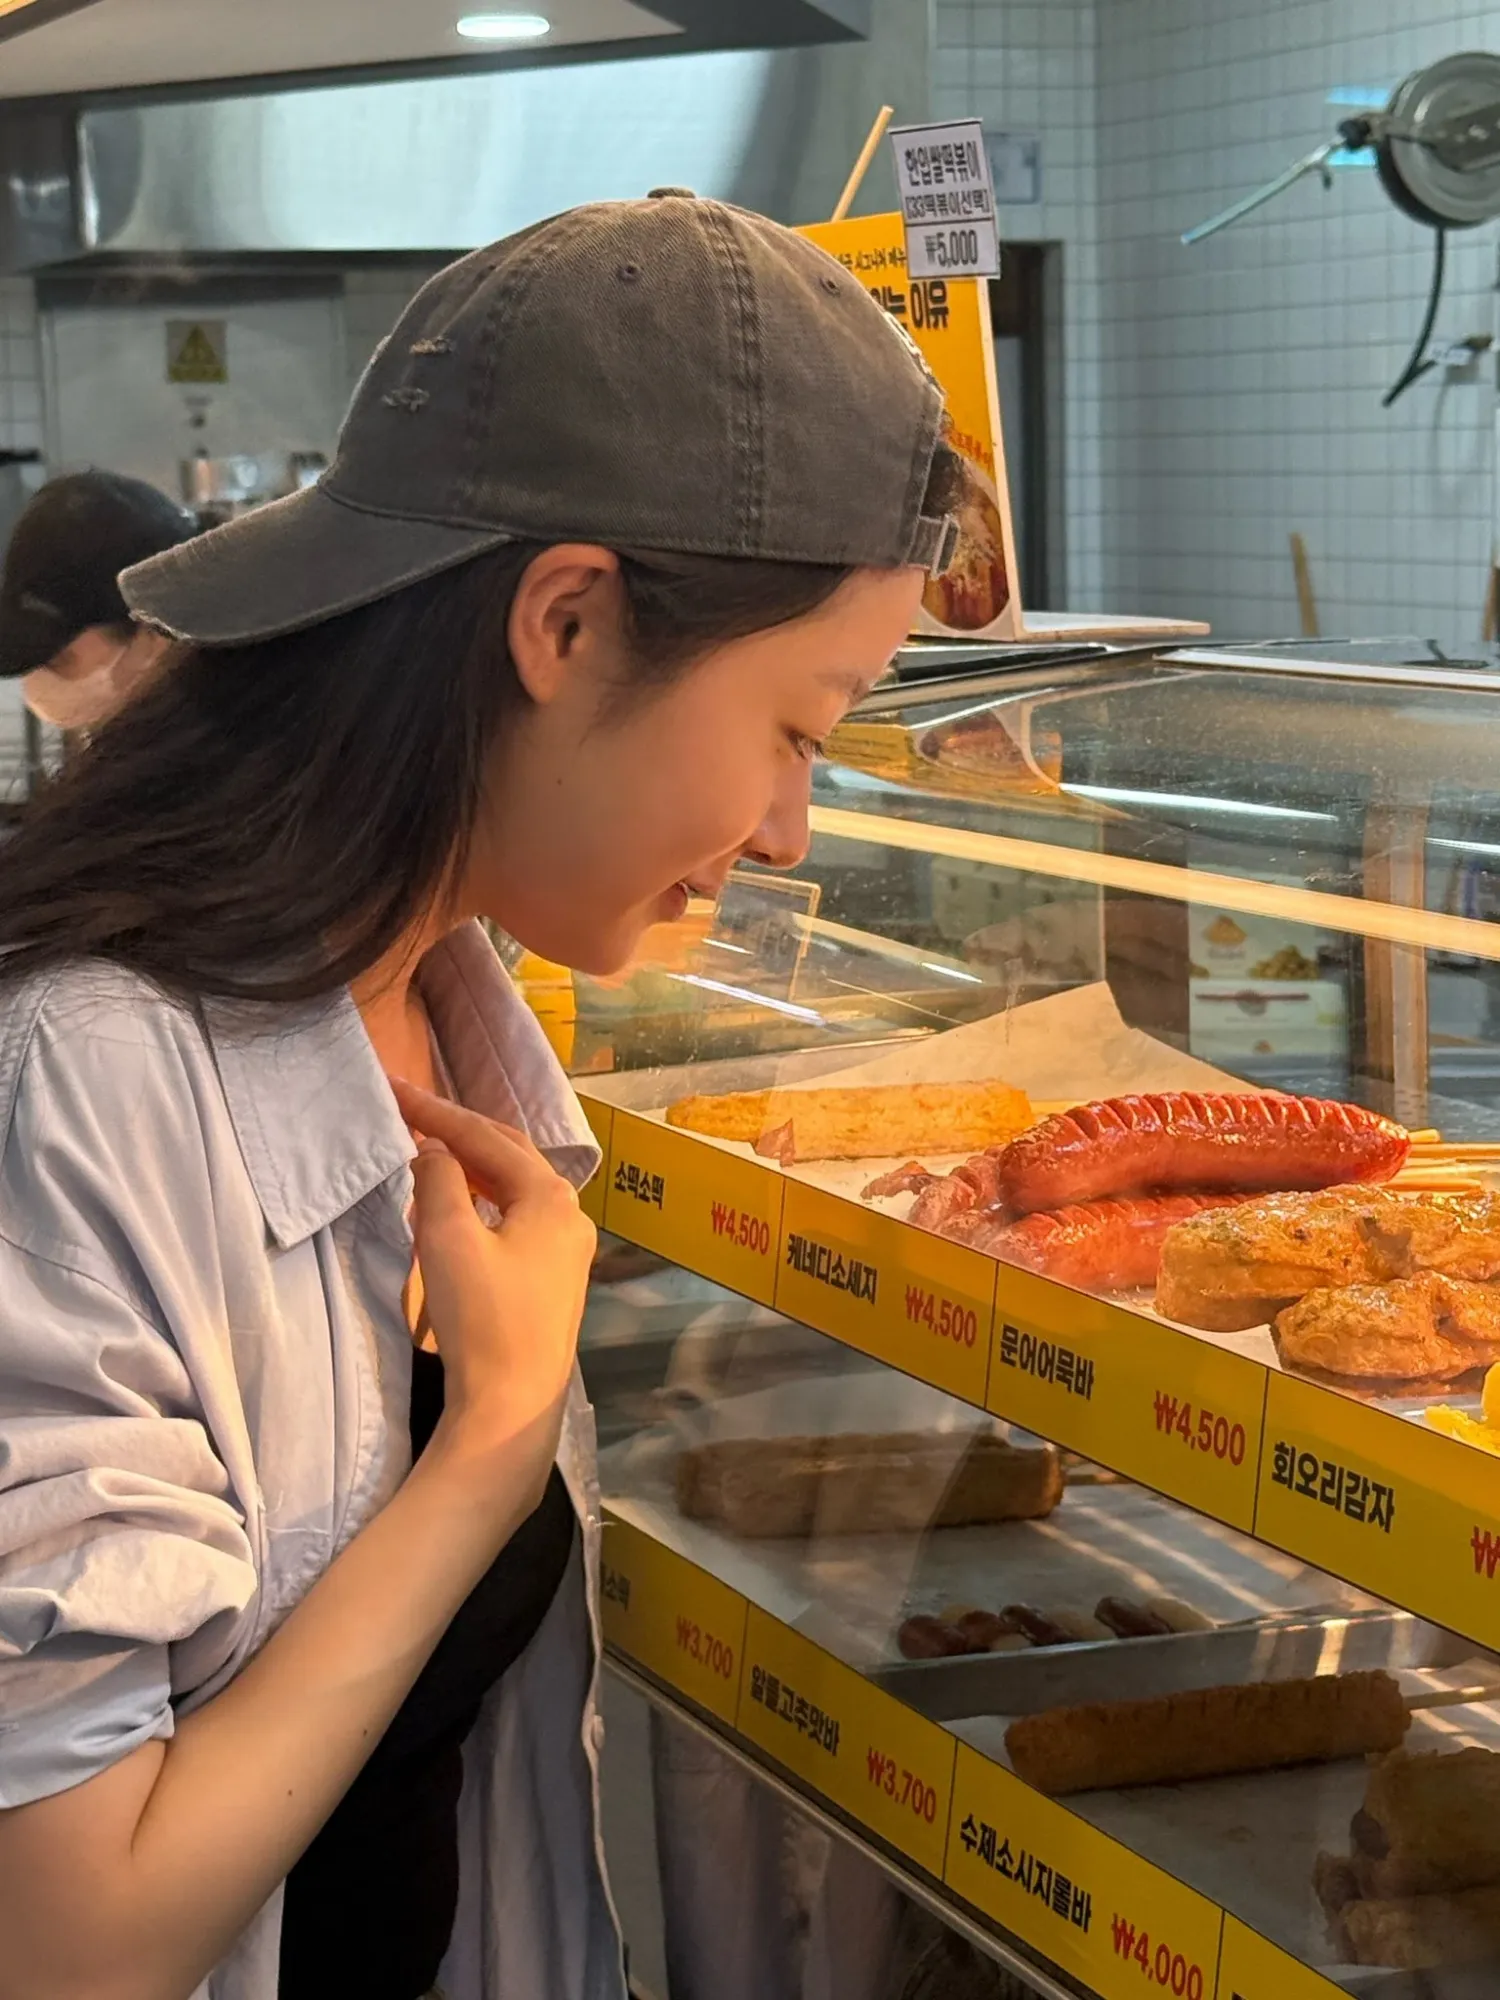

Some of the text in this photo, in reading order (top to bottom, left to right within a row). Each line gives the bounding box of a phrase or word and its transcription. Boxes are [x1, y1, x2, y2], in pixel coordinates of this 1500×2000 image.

[911, 281, 949, 329] 이유
[615, 1161, 770, 1255] 소떡소떡 ₩4,500
[786, 1232, 977, 1347] 케네디소세지 ₩4,500
[1000, 1323, 1246, 1466] 문어어묵바 ₩4,500
[1271, 1441, 1395, 1533] 회오리감자
[676, 1615, 734, 1679] ₩3,700
[866, 1747, 937, 1824] ₩3,700
[960, 1813, 1203, 2000] 수제소시지롤바 ₩4,000
